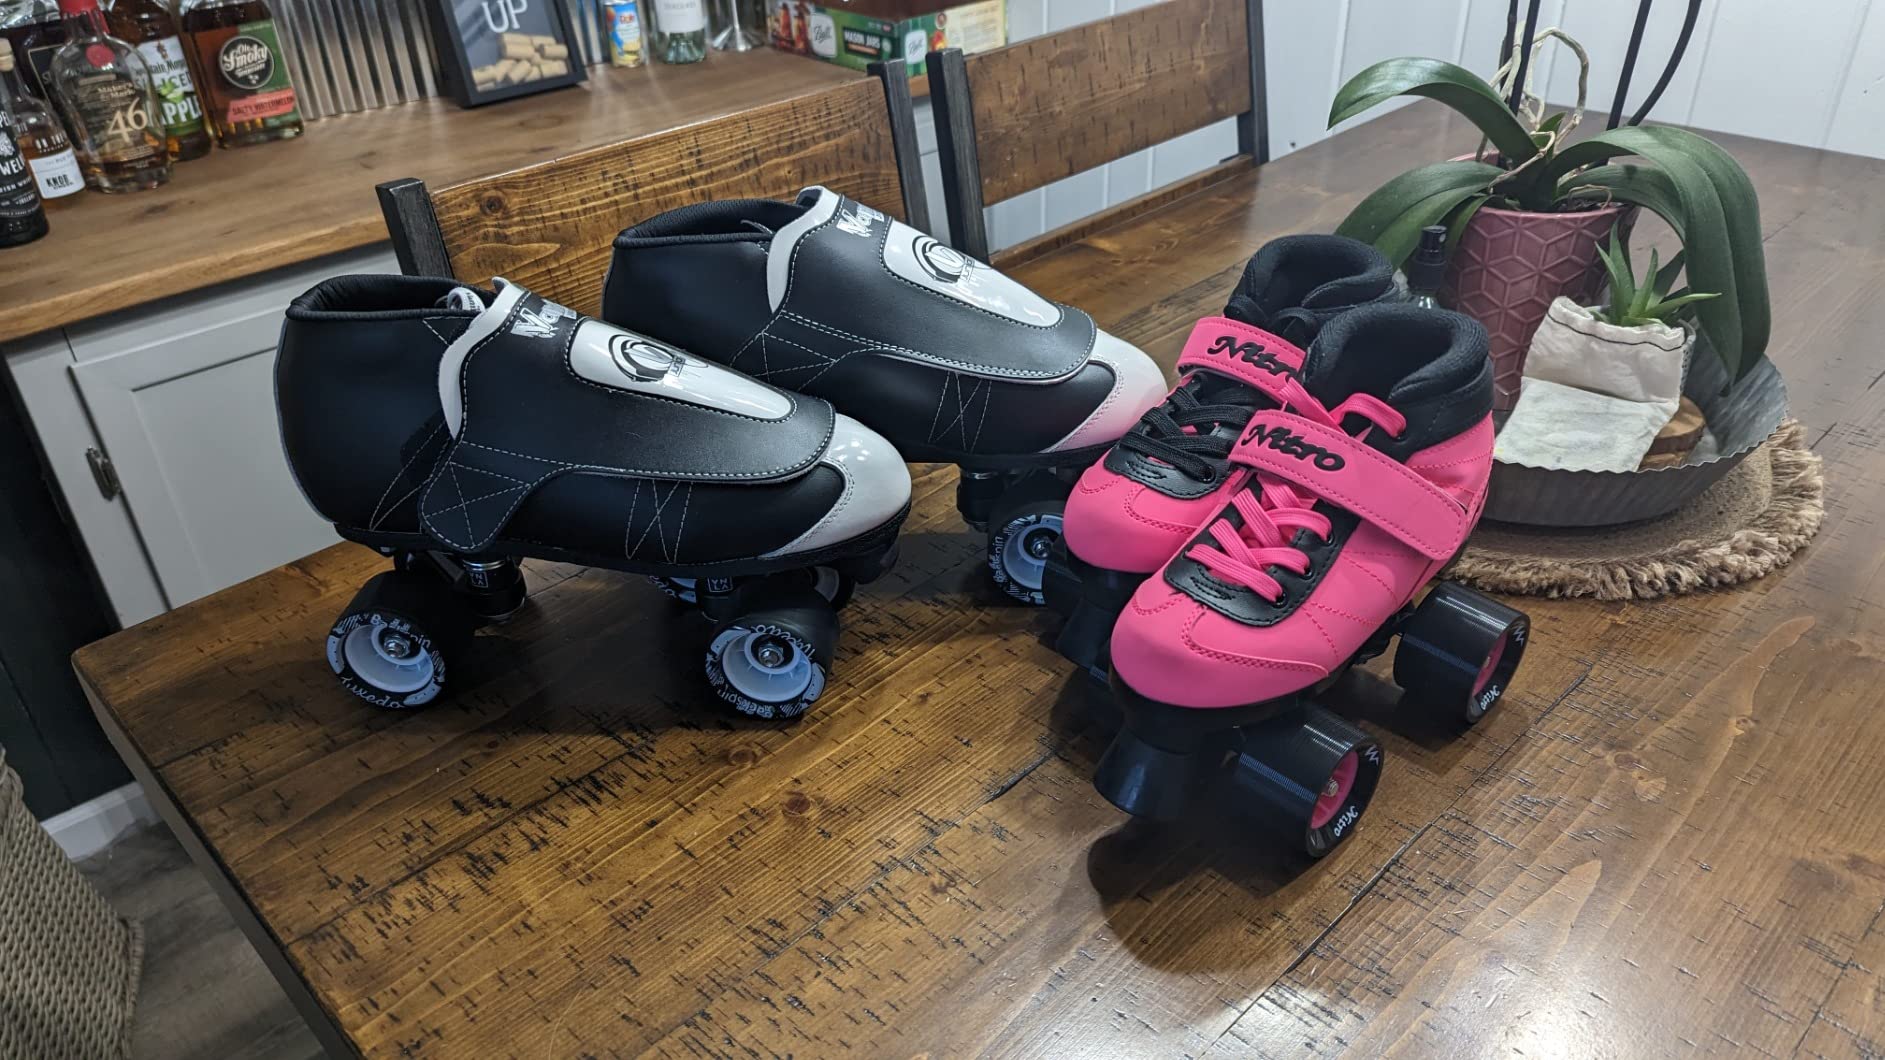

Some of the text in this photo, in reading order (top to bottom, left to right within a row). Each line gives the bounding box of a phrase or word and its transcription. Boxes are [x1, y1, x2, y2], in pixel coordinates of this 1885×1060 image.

[481, 0, 528, 33] UP
[223, 44, 268, 72] Smoky
[108, 97, 148, 143] 46
[1241, 424, 1346, 472] Nitro
[341, 676, 404, 709] Tuxedo
[1480, 684, 1501, 711] Nitro
[1333, 805, 1360, 838] Nitro
